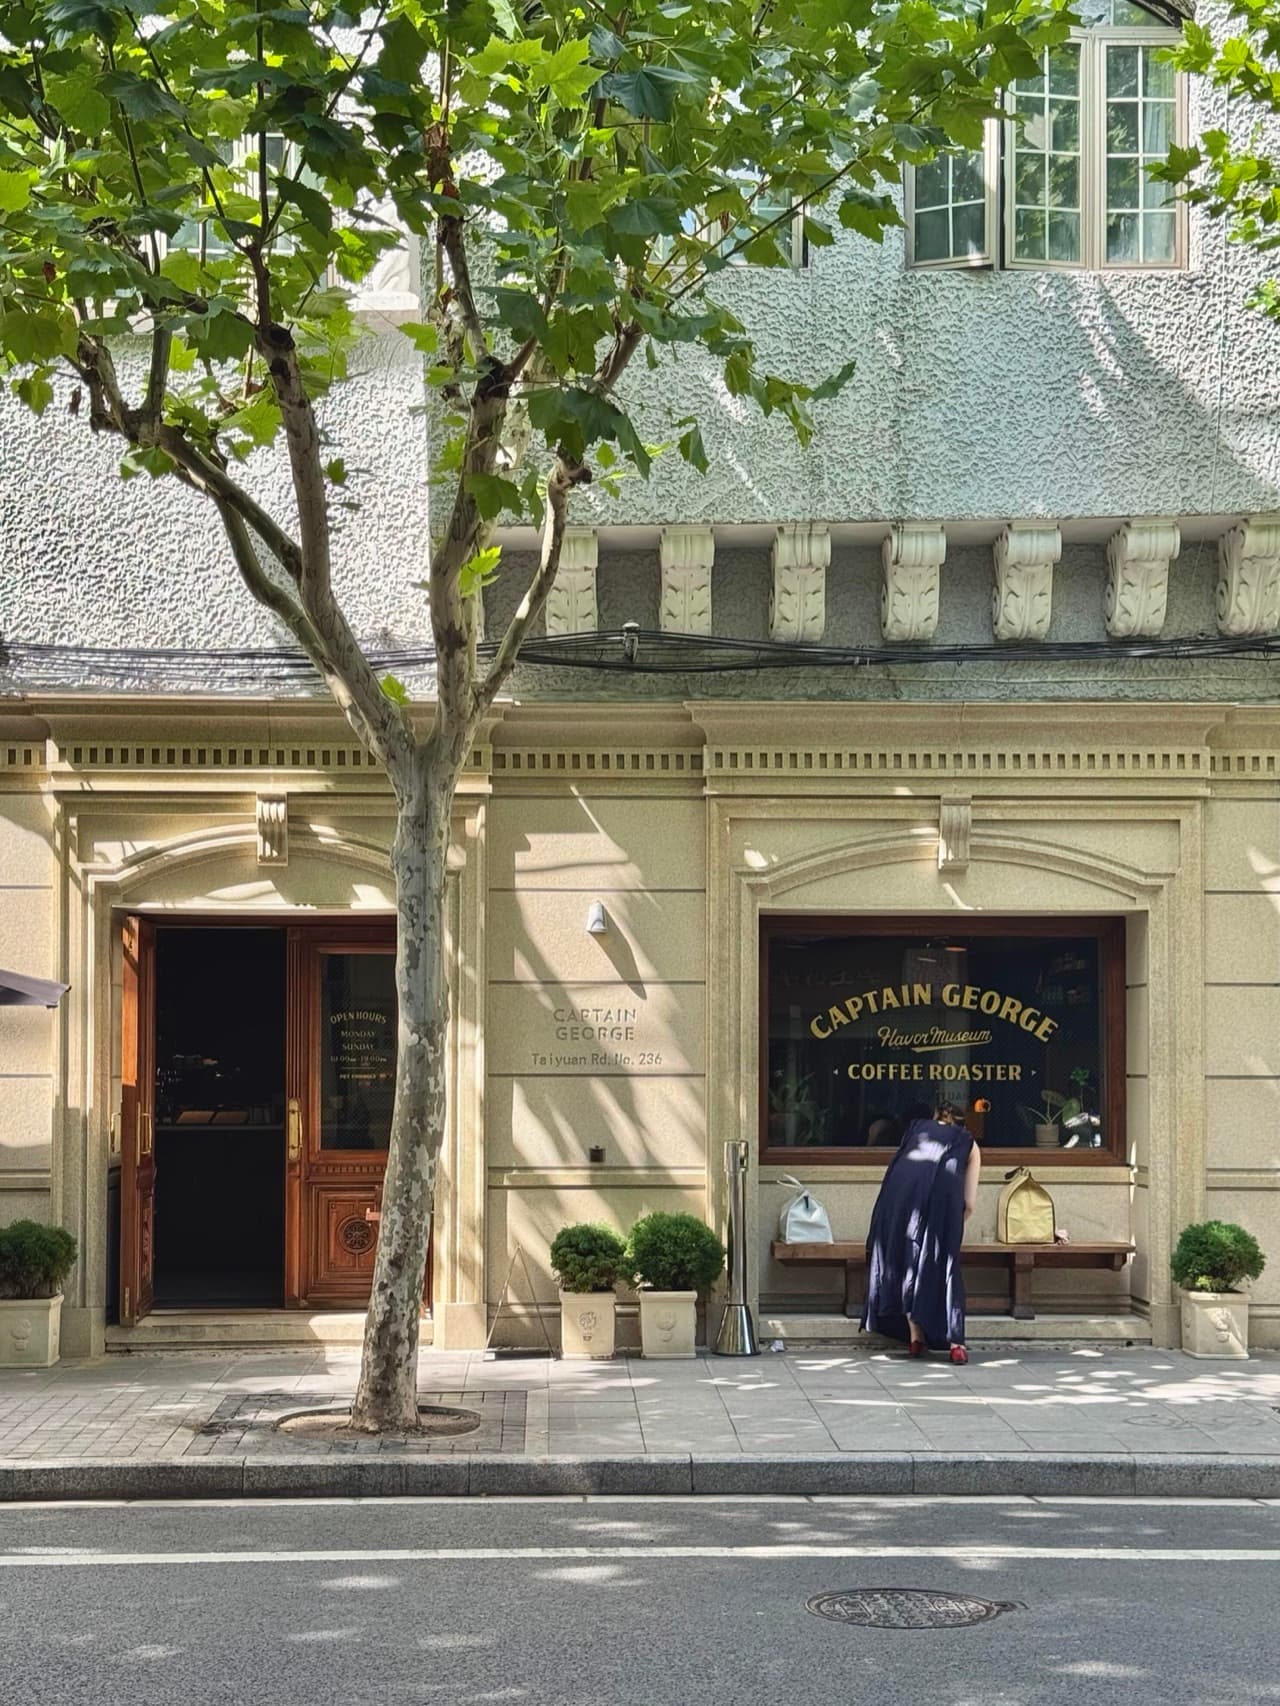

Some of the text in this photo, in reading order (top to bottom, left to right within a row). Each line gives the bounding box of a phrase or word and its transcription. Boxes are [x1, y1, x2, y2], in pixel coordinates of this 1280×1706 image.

[330, 1011, 386, 1024] OPEN HOURS
[809, 983, 1058, 1042] CAPTAIN GEORGE
[553, 1008, 636, 1041] CAPTAIN GEORGE
[341, 1030, 376, 1038] MONDAY
[877, 1026, 992, 1048] Flavor Museum
[532, 1053, 587, 1066] Taiyuan
[591, 1053, 611, 1065] Rd.
[639, 1053, 662, 1065] 236
[848, 1064, 1021, 1081] COFFEE ROASTER
